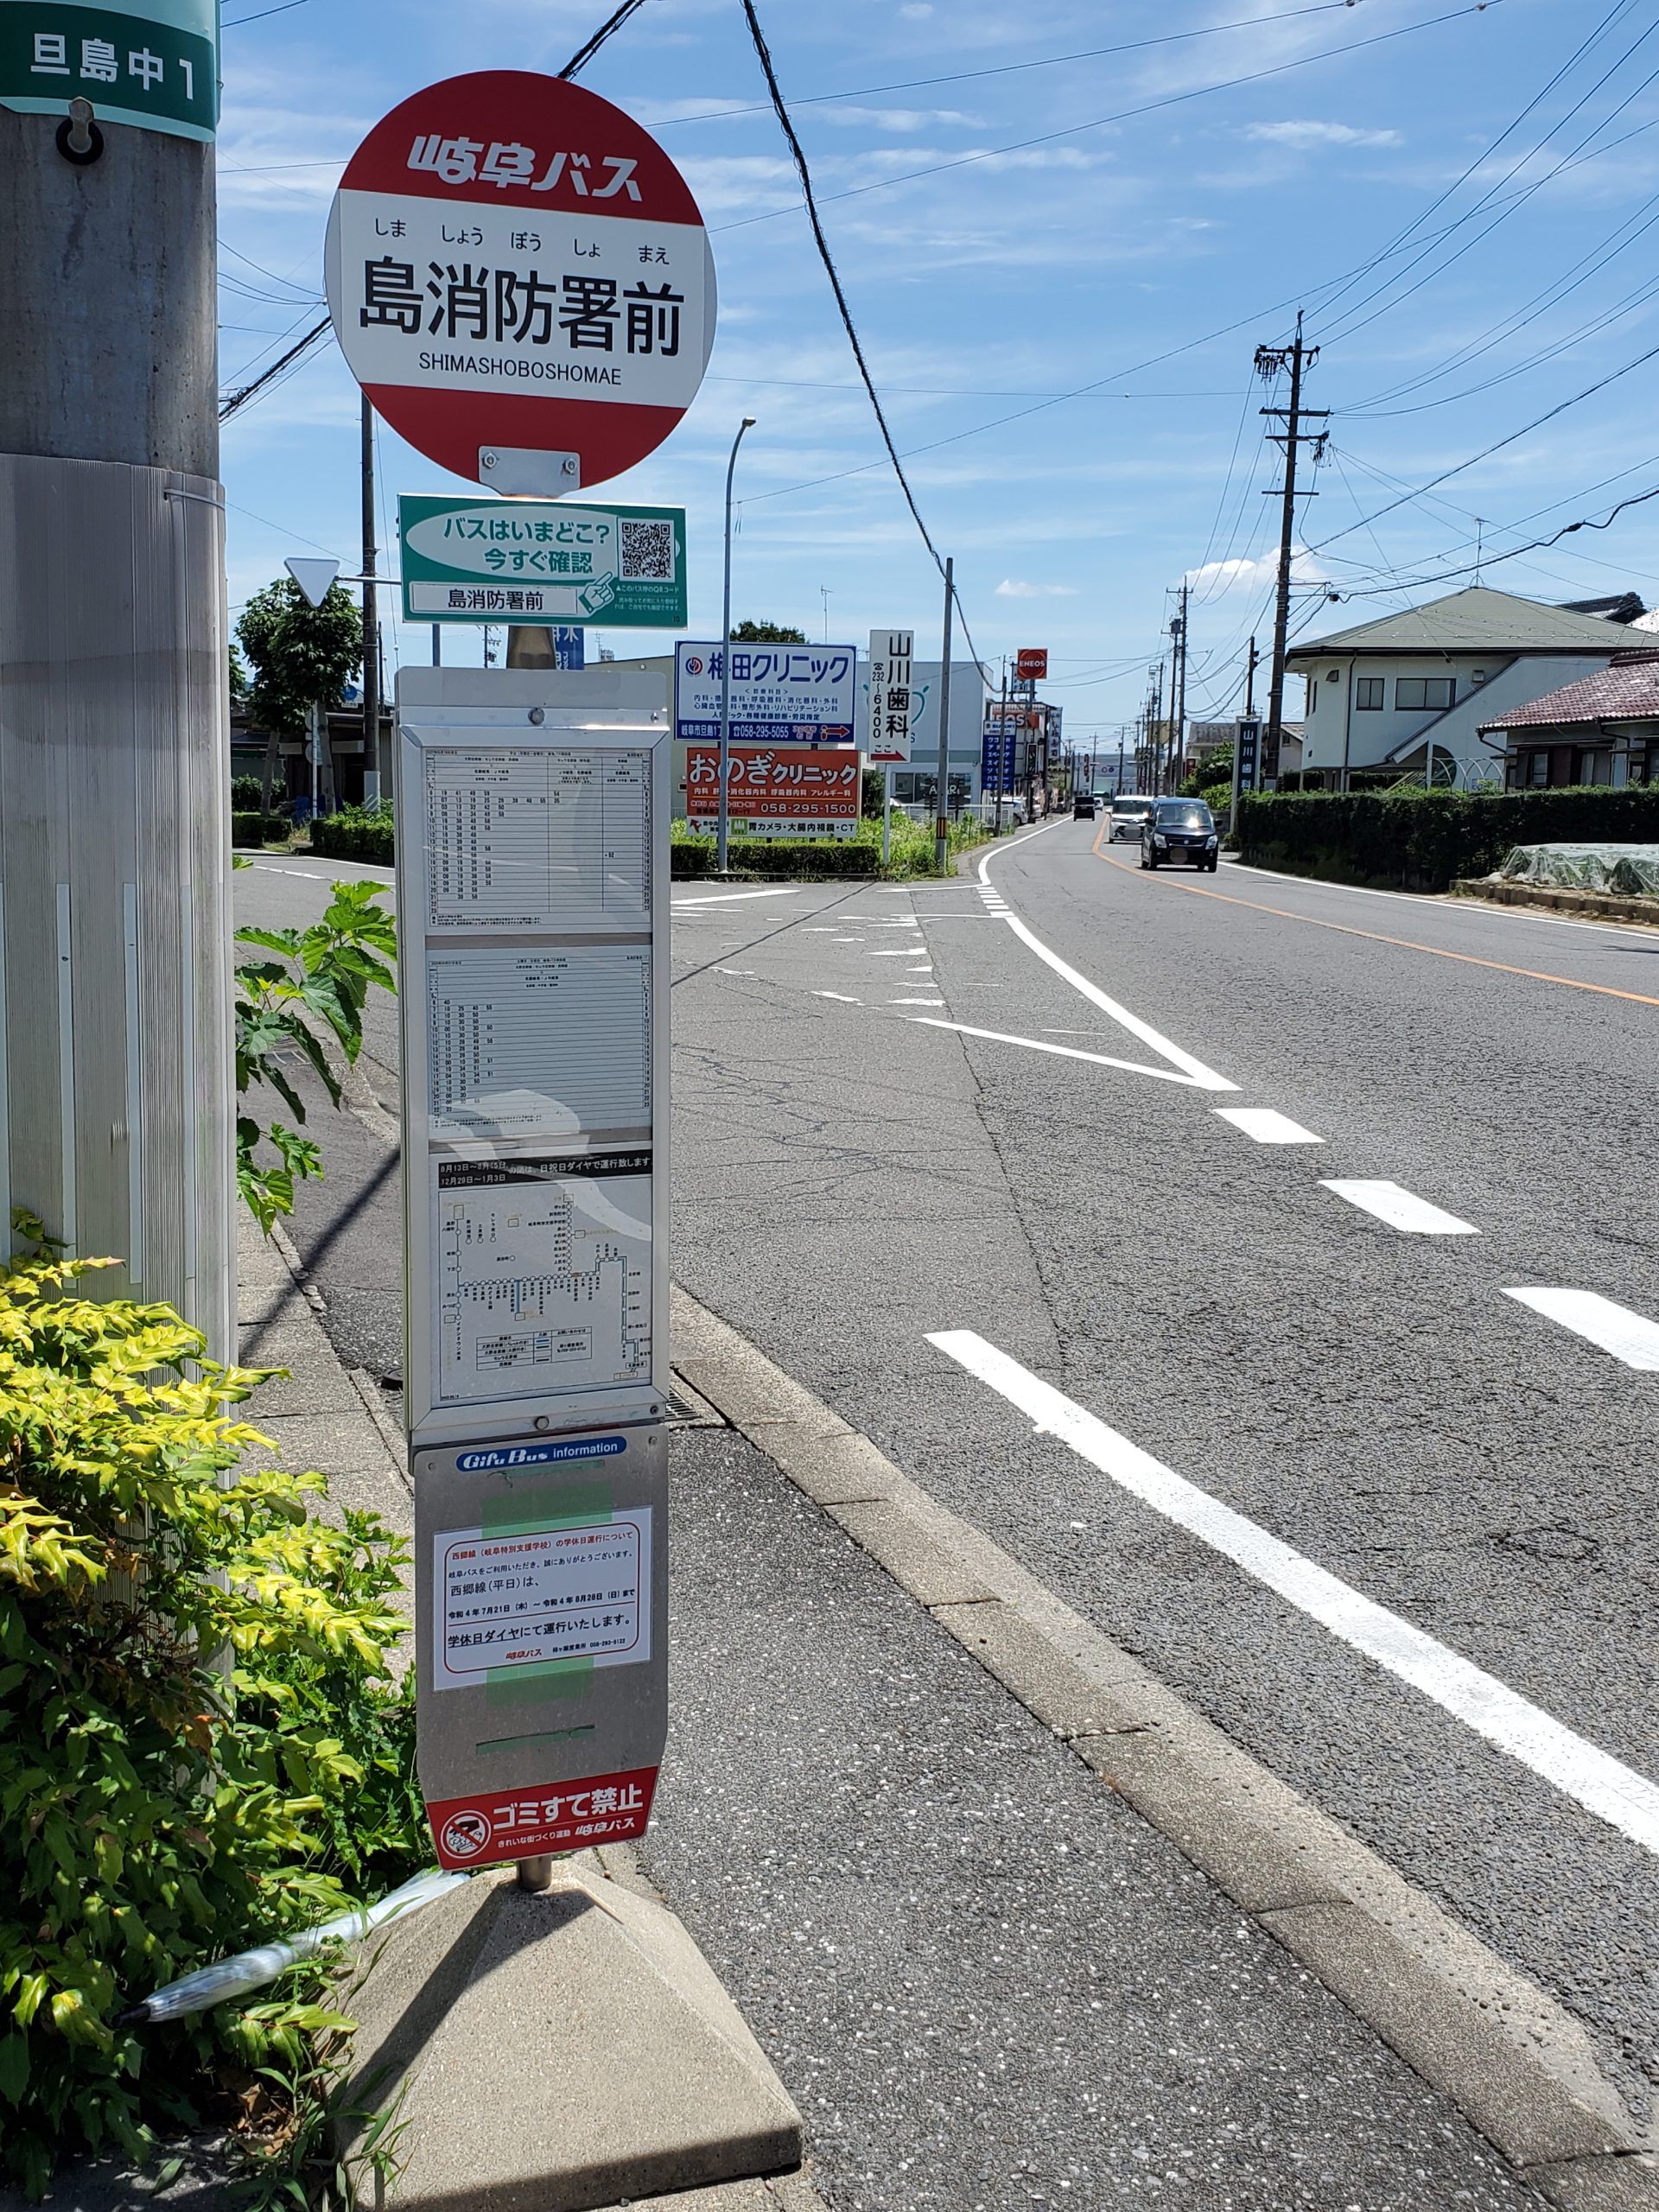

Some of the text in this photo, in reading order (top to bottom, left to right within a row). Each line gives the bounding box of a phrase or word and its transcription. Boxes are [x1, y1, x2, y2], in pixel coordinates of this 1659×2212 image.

[30, 33, 194, 100] 旦島中1
[407, 134, 643, 202] 岐阜バス
[375, 218, 670, 265] しま しょう ぼう しょ まえ
[359, 255, 684, 357] 島消防署前
[419, 352, 621, 385] SHIMASHOBOSHOMAE
[444, 518, 610, 544] バスはいまどこ?
[484, 548, 593, 574] 今すぐ確認
[448, 588, 543, 610] 島消防署前
[886, 633, 911, 739] 山川歯科
[874, 744, 892, 753] ここ
[690, 752, 857, 785] おのぎクリニック
[463, 1441, 618, 1468] Gifu Bus information
[448, 1614, 630, 1647] 学休日ダイヤにて運行いたします。
[505, 1649, 543, 1660] 岐阜バス
[493, 1783, 643, 1830] ゴミすて禁止
[498, 1817, 635, 1848] きれいな街づくり運動 岐阜バス
